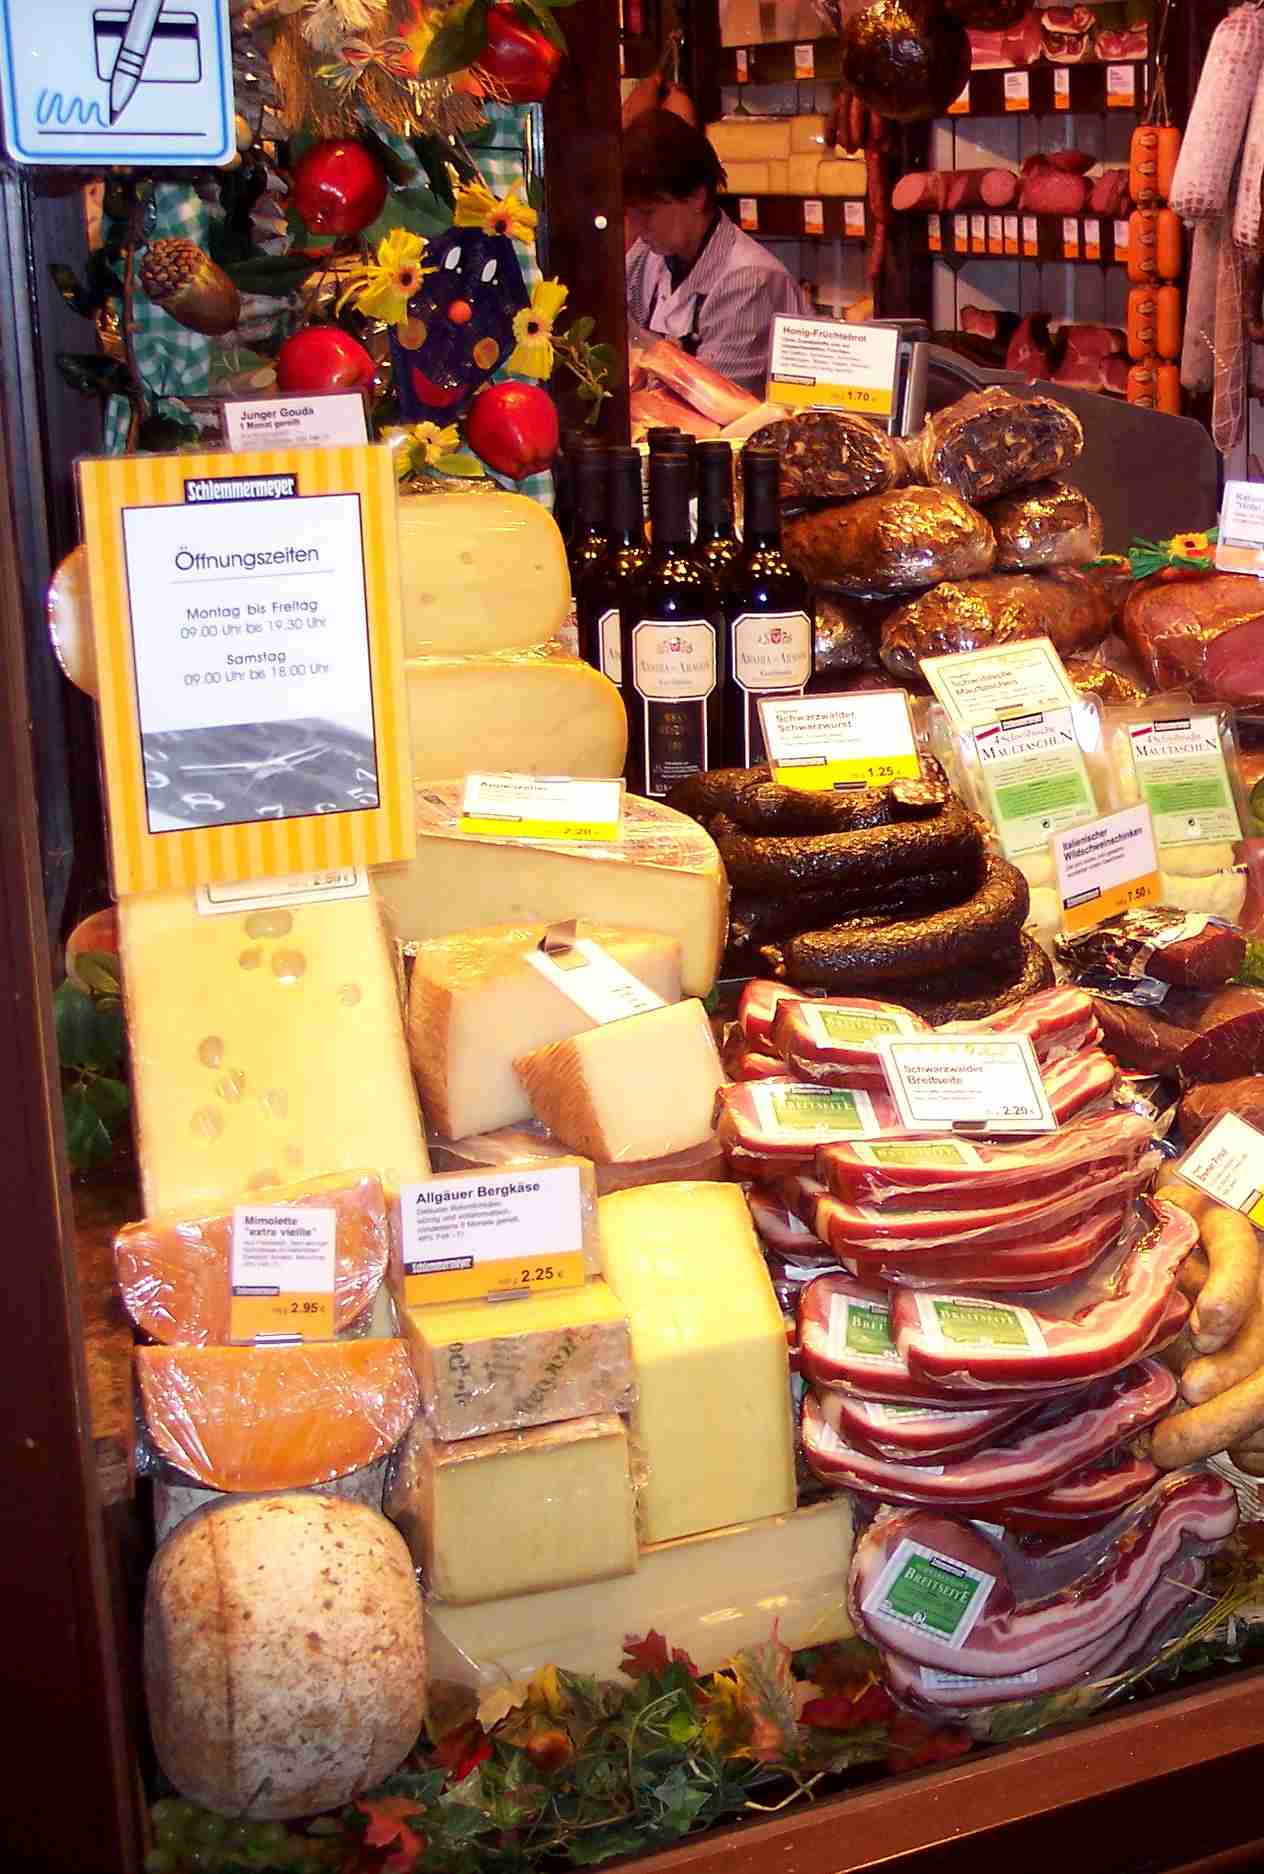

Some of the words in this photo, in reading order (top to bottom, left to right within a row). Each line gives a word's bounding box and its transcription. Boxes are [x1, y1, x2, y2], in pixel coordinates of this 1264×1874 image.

[240, 409, 276, 421] Junger
[280, 407, 314, 417] Gouda
[187, 478, 294, 501] Schlemmermeyer
[175, 546, 319, 570] Öffnungszeiten
[187, 607, 240, 621] Montag
[247, 604, 266, 615] bis
[272, 601, 318, 614] Freitag
[180, 625, 217, 639] 09.00
[222, 624, 241, 636] Uhr
[246, 623, 263, 634] bis
[269, 619, 303, 631] 19.30
[307, 617, 326, 628] Uhr
[227, 652, 286, 665] Samstag
[184, 672, 221, 686] 09.00
[225, 671, 245, 682] Uhr
[250, 669, 266, 680] bis
[272, 664, 306, 677] 18.00
[310, 664, 329, 674] Uhr
[416, 1189, 474, 1205] Allgäuer
[477, 1182, 541, 1198] Bergkäse
[244, 1216, 298, 1225] Mimolette
[521, 1267, 554, 1283] 2.25
[291, 1302, 318, 1313] 2.95
[904, 1567, 970, 1602] BREITSEITE
